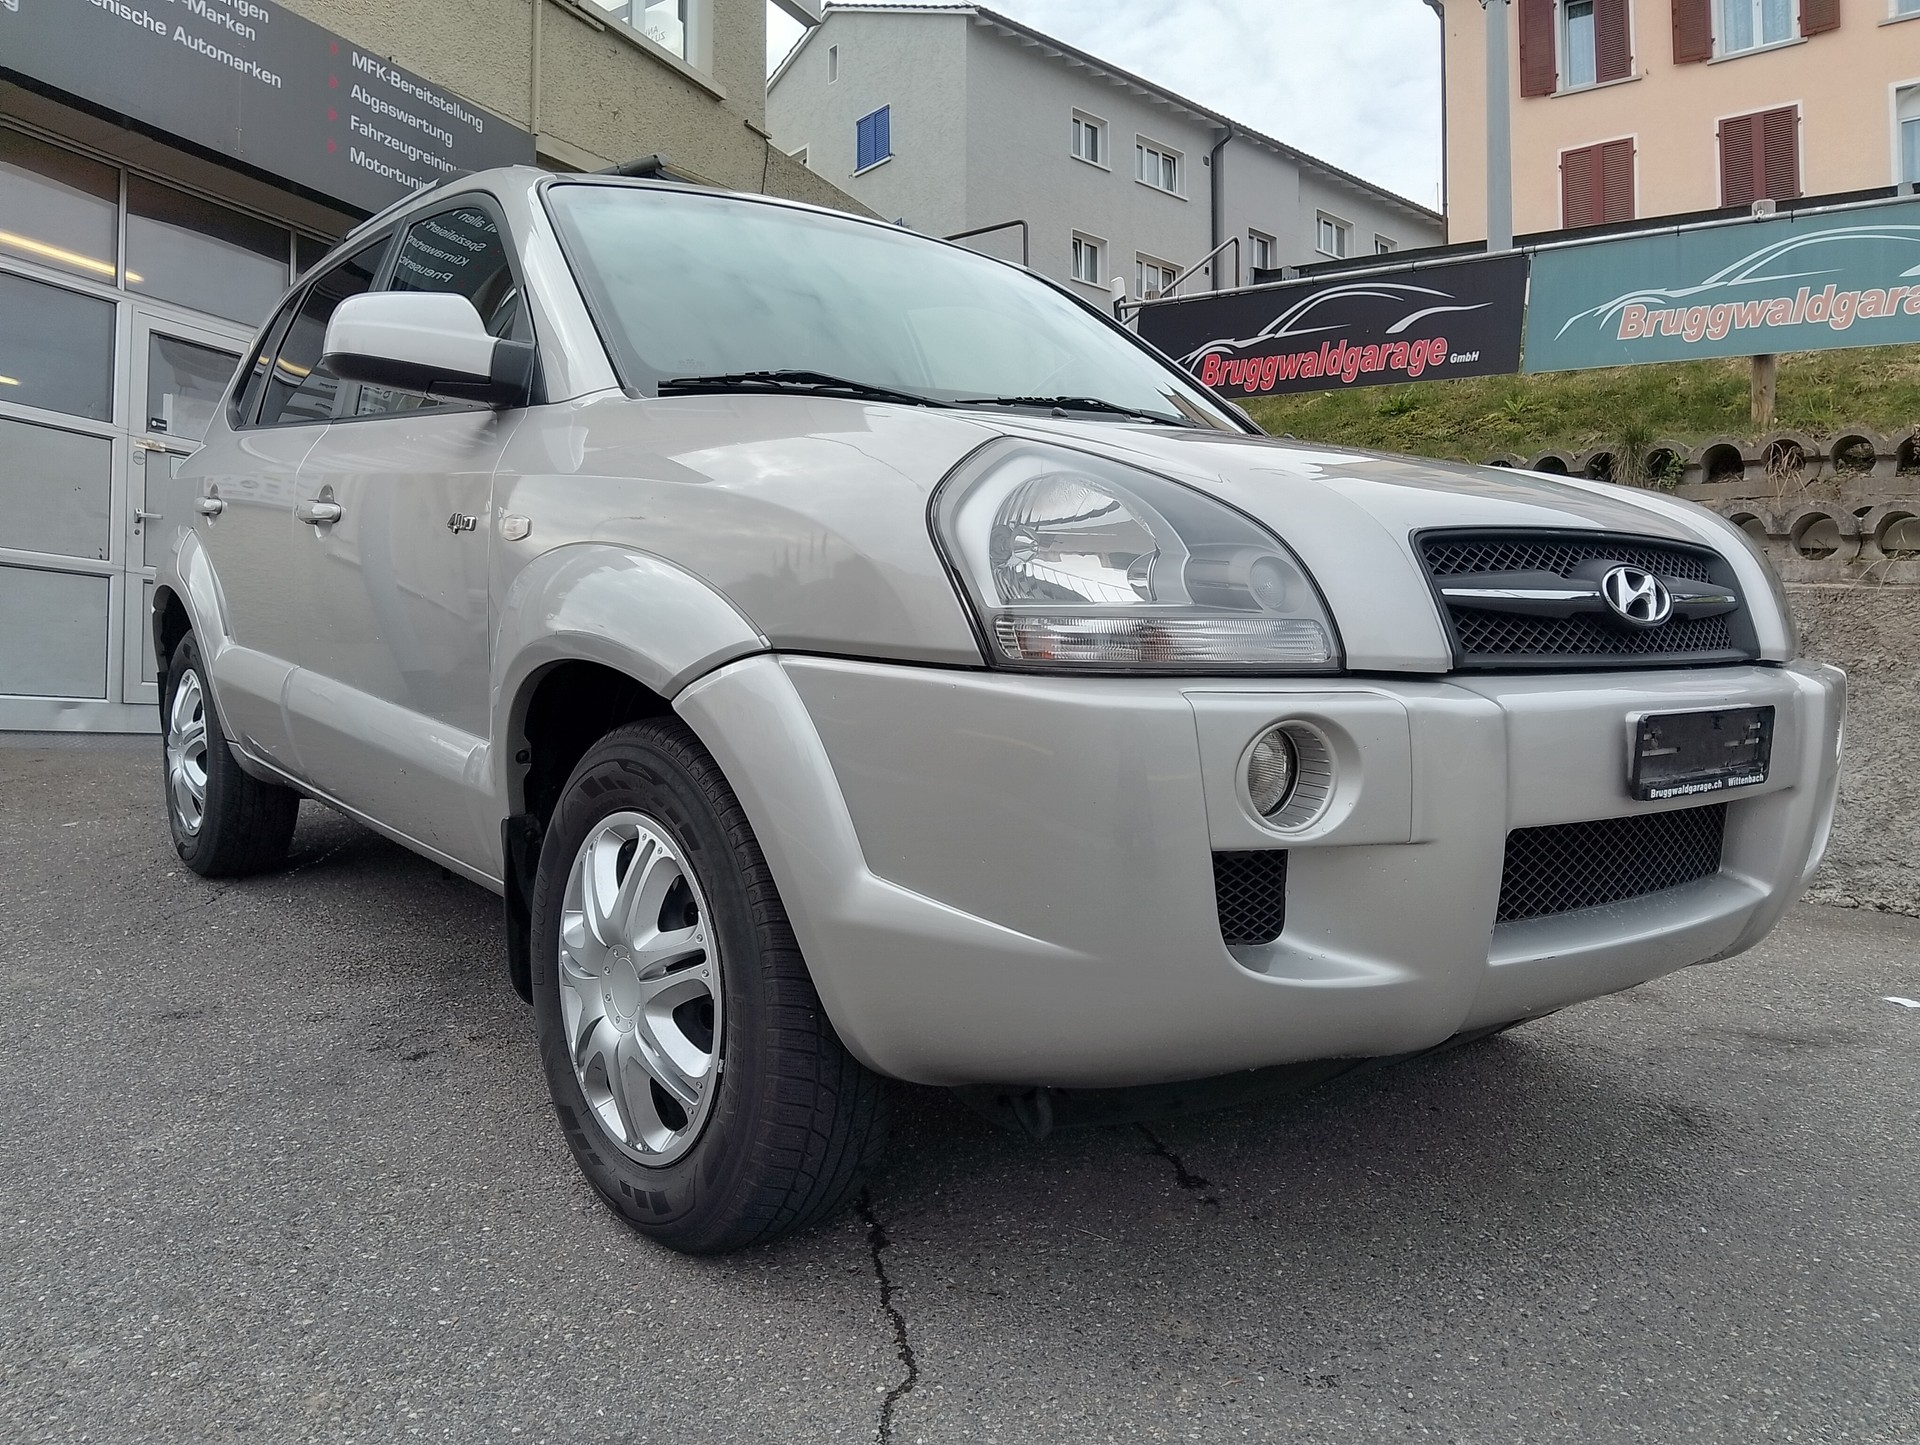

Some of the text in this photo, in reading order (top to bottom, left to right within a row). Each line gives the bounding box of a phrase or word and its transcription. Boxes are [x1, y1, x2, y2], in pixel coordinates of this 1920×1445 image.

[173, 26, 281, 88] Automarken
[350, 84, 453, 148] Abgaswartung
[352, 51, 483, 133] MFK-Bereitstellung
[1201, 337, 1480, 392] Bruggwaldgarage GmbH
[1650, 773, 1764, 798] Bruggwaldgarage.ch Wittenbach
